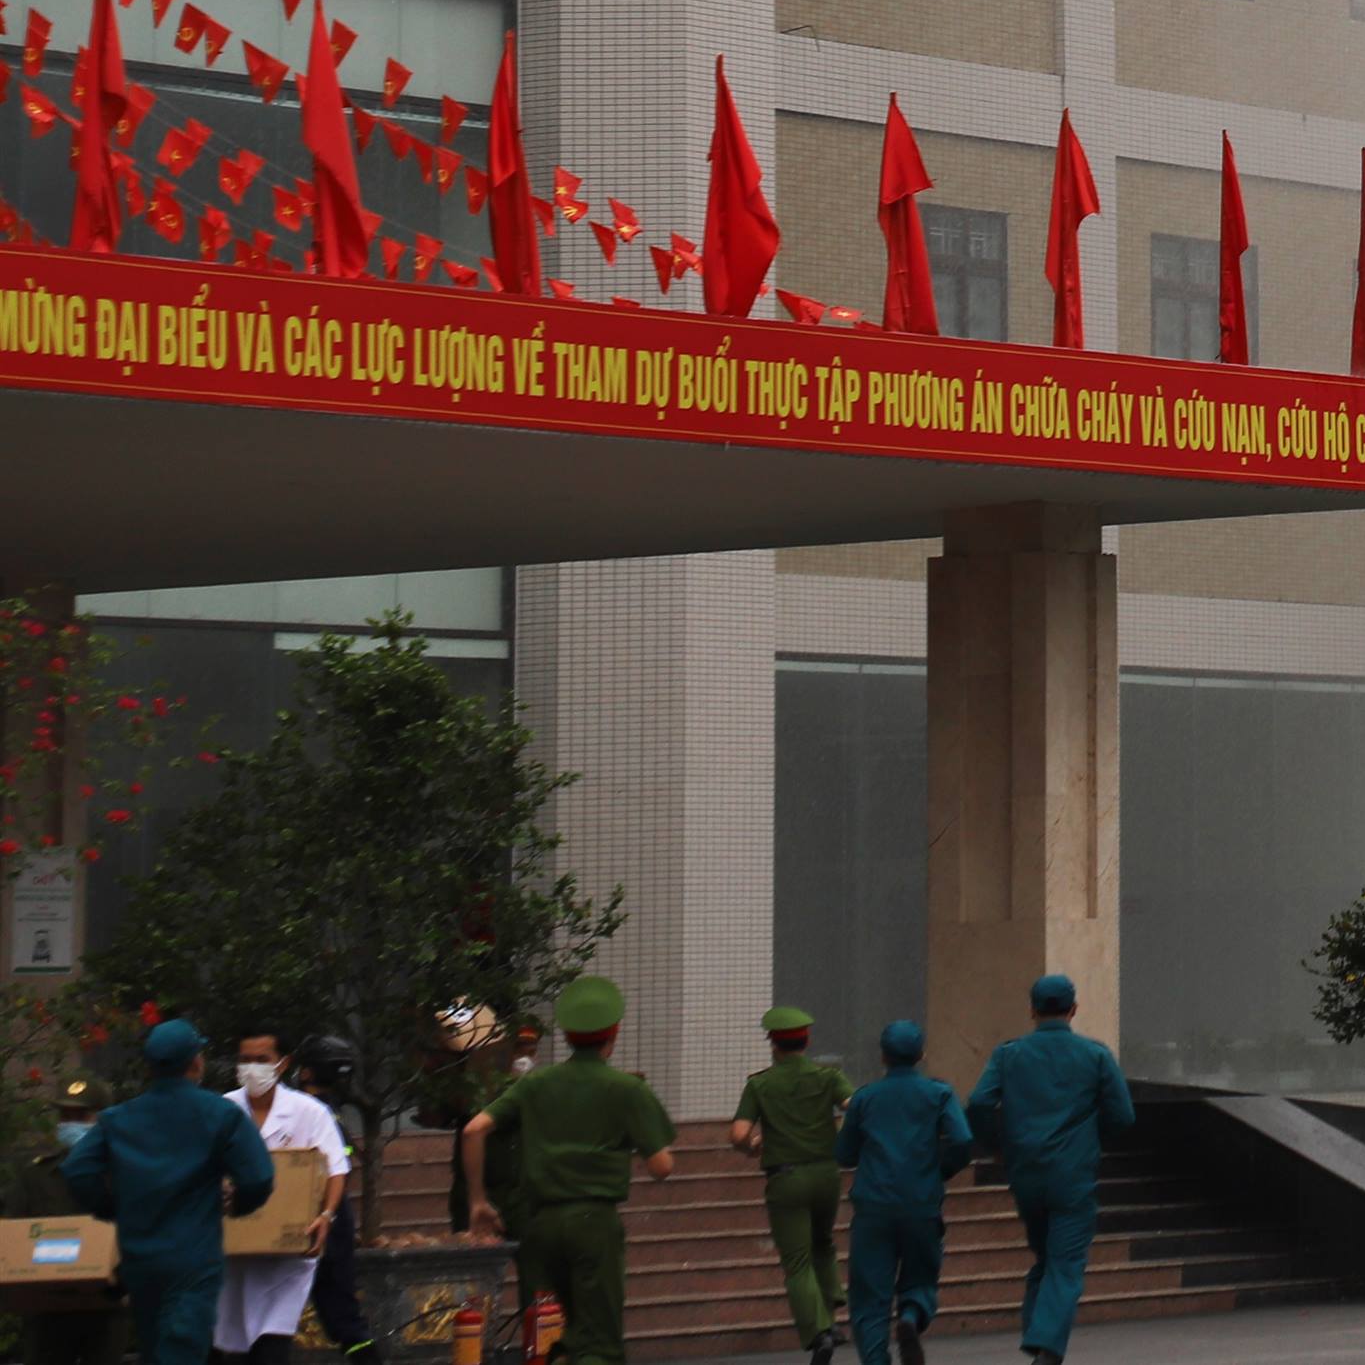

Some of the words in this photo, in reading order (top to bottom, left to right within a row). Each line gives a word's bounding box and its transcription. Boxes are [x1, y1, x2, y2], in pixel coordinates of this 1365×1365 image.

[0, 277, 87, 357] MỪNG
[95, 299, 148, 376] ĐẠI
[159, 283, 228, 370] BIỂU
[236, 302, 276, 373] VÀ
[284, 306, 343, 379] CÁC
[351, 319, 406, 396] LỰC
[413, 325, 505, 403] LƯỢNG
[513, 321, 546, 397] VỀ
[553, 342, 629, 405] THAM
[636, 348, 674, 420] DỰ
[678, 336, 738, 414] BUỔI
[745, 358, 809, 430] THỰC
[815, 356, 862, 434] TẬP
[868, 370, 965, 433] PHƯƠNG
[971, 370, 1004, 435] ÁN
[1010, 376, 1072, 440] CHỮA
[1077, 381, 1135, 446] CHÁY
[1139, 386, 1169, 448] VÀ
[1174, 389, 1217, 452] CỨU
[1221, 402, 1273, 464] NẠN,
[1277, 398, 1319, 460] CỨU
[1323, 403, 1351, 473] HỘ
